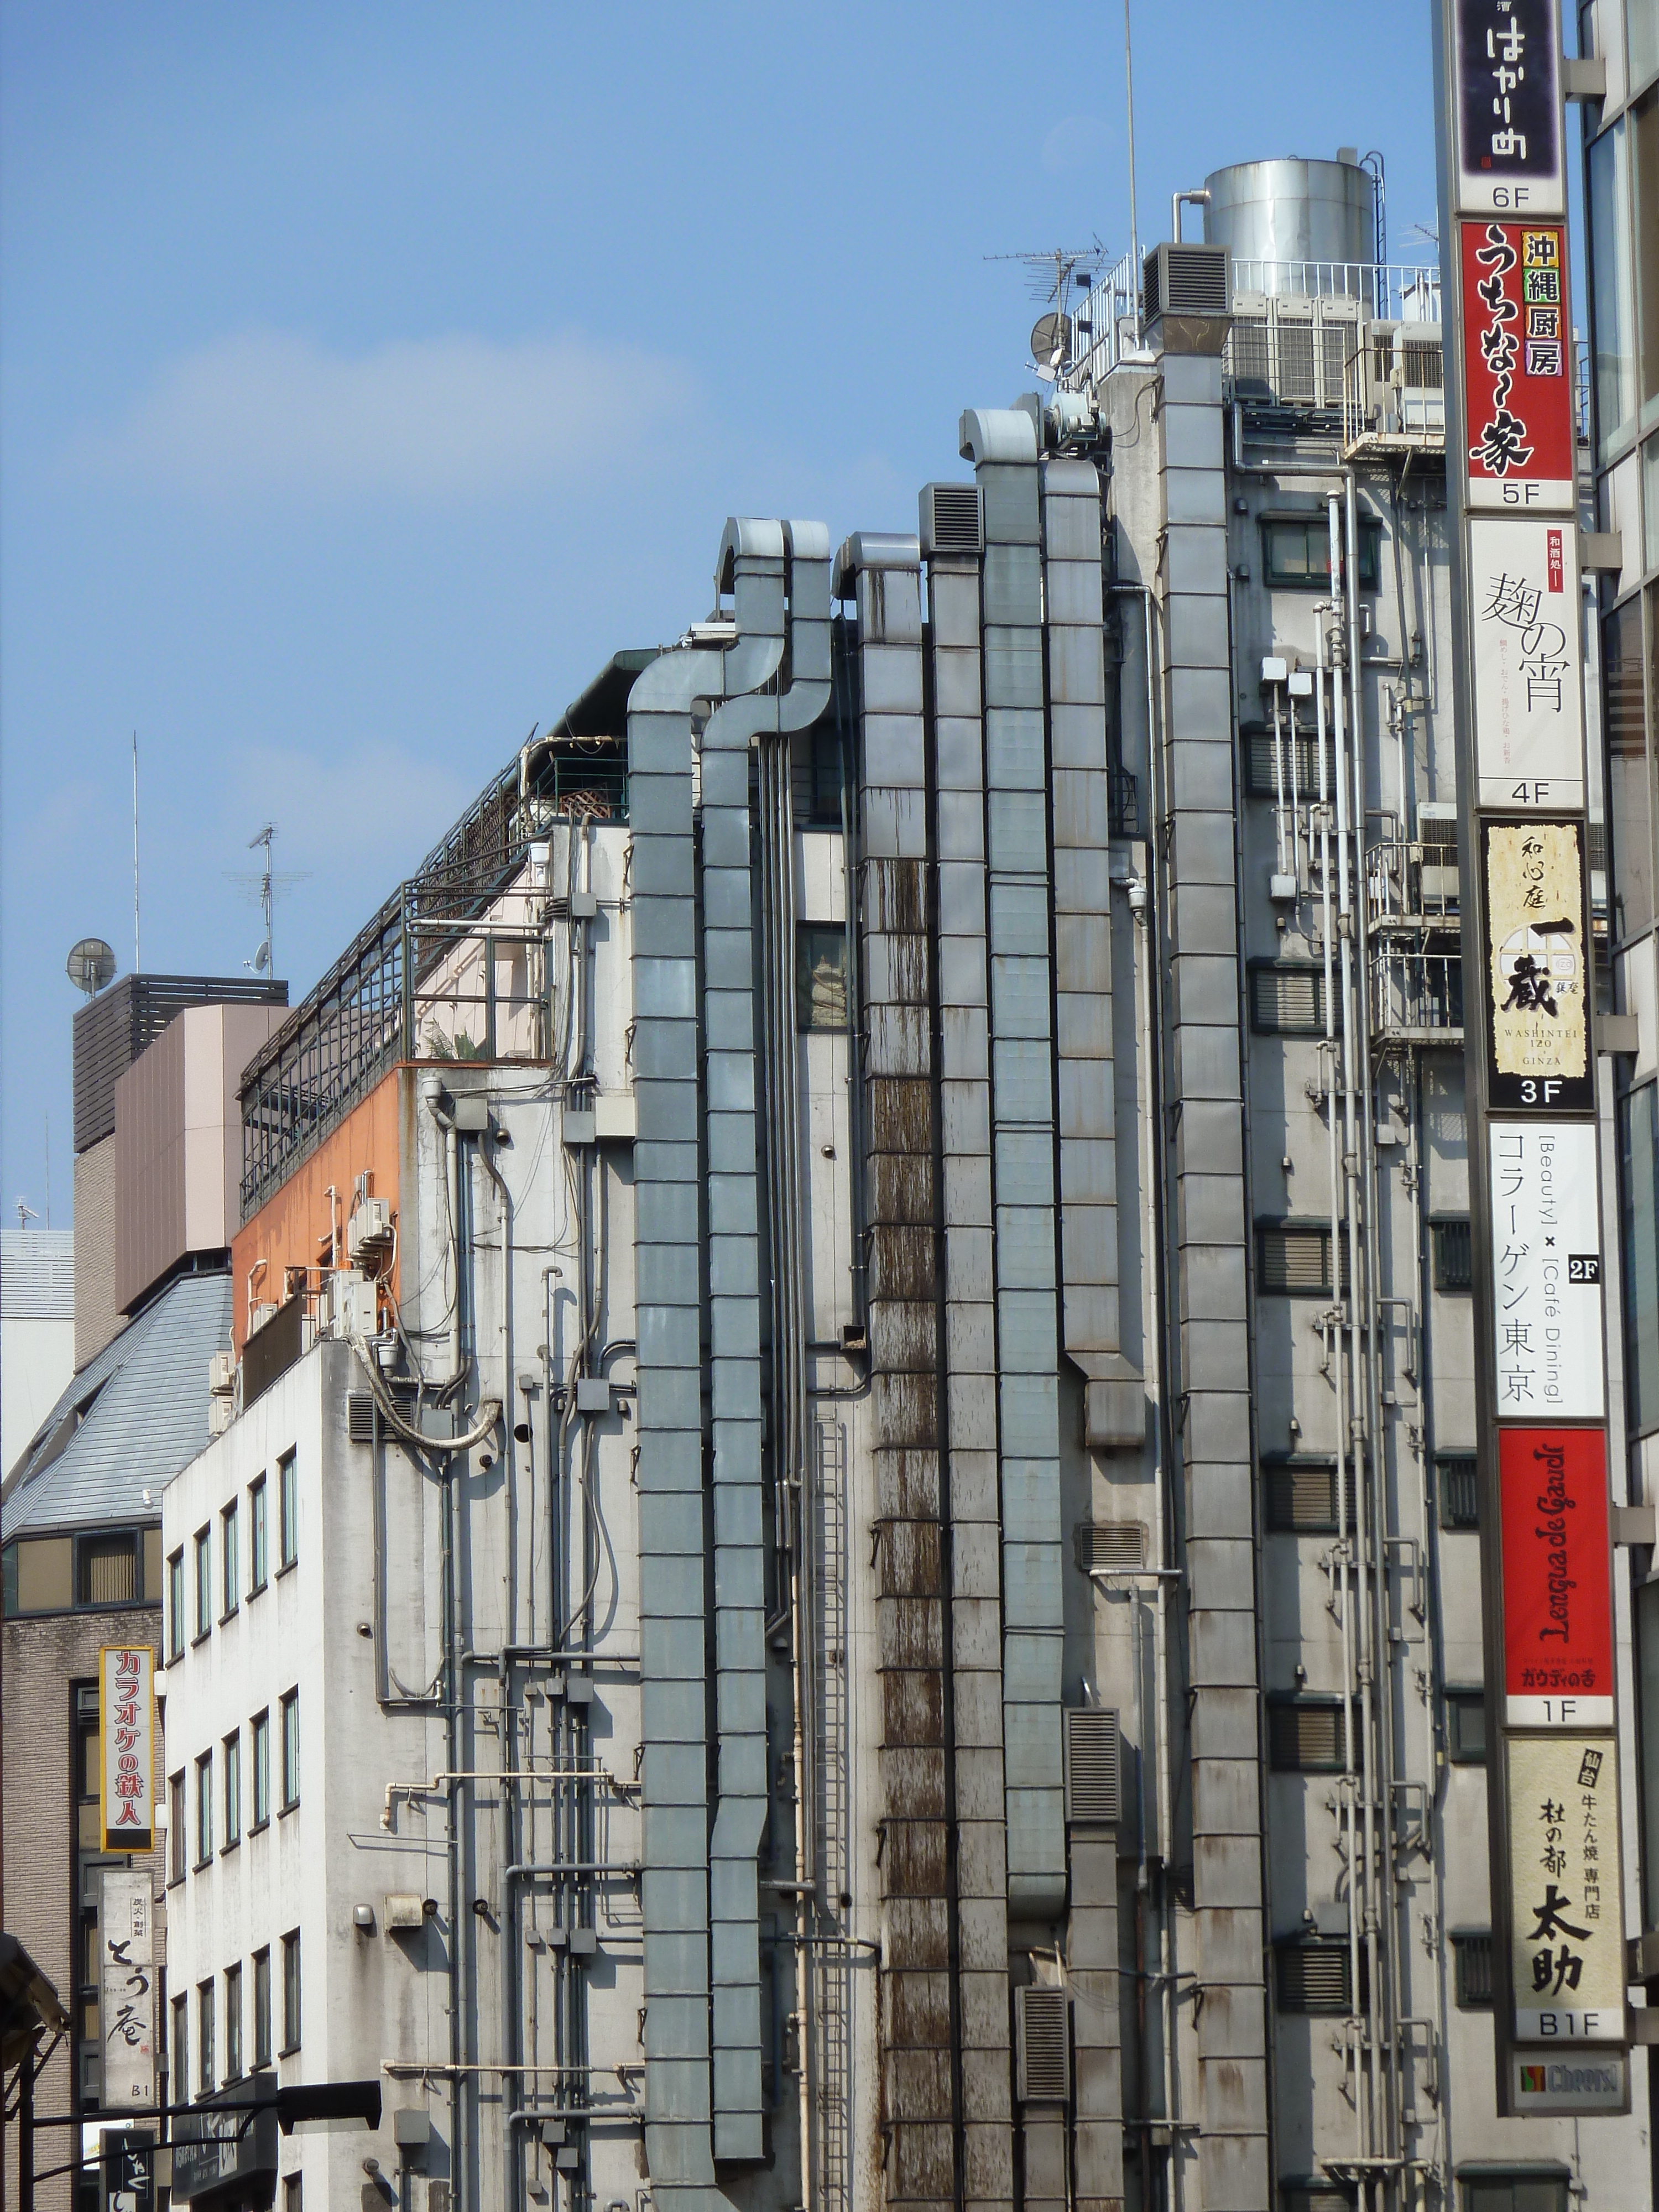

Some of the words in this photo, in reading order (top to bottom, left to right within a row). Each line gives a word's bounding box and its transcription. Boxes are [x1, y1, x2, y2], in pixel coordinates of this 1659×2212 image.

[1486, 17, 1526, 159] はかりめ
[1493, 187, 1530, 208] 6F
[1526, 234, 1561, 374] 沖縄厨房
[1503, 483, 1540, 504] 5F
[1511, 782, 1550, 804] 4F
[1521, 836, 1546, 909] 和心庭
[1556, 982, 1579, 994] 銀座
[1504, 1030, 1577, 1038] WASHINTEI
[1530, 1040, 1552, 1048] IZO
[1522, 1057, 1561, 1065] GINZA
[1520, 1081, 1563, 1103] 3F
[1499, 1135, 1536, 1403] コラーゲン東京
[1571, 1260, 1598, 1280] 2F
[1535, 1517, 1566, 1547] de
[1538, 1550, 1577, 1644] Lengua
[1521, 1667, 1596, 1687] ガウディの舌
[1543, 1700, 1576, 1722] 1F
[114, 1651, 144, 1825] カラオケの鉄人
[1579, 1749, 1603, 1787] 仙台
[1540, 1798, 1566, 1879] 杜の都
[1527, 1885, 1594, 1997] 太助
[1540, 2013, 1599, 2036] B1F
[132, 2085, 149, 2097] B1
